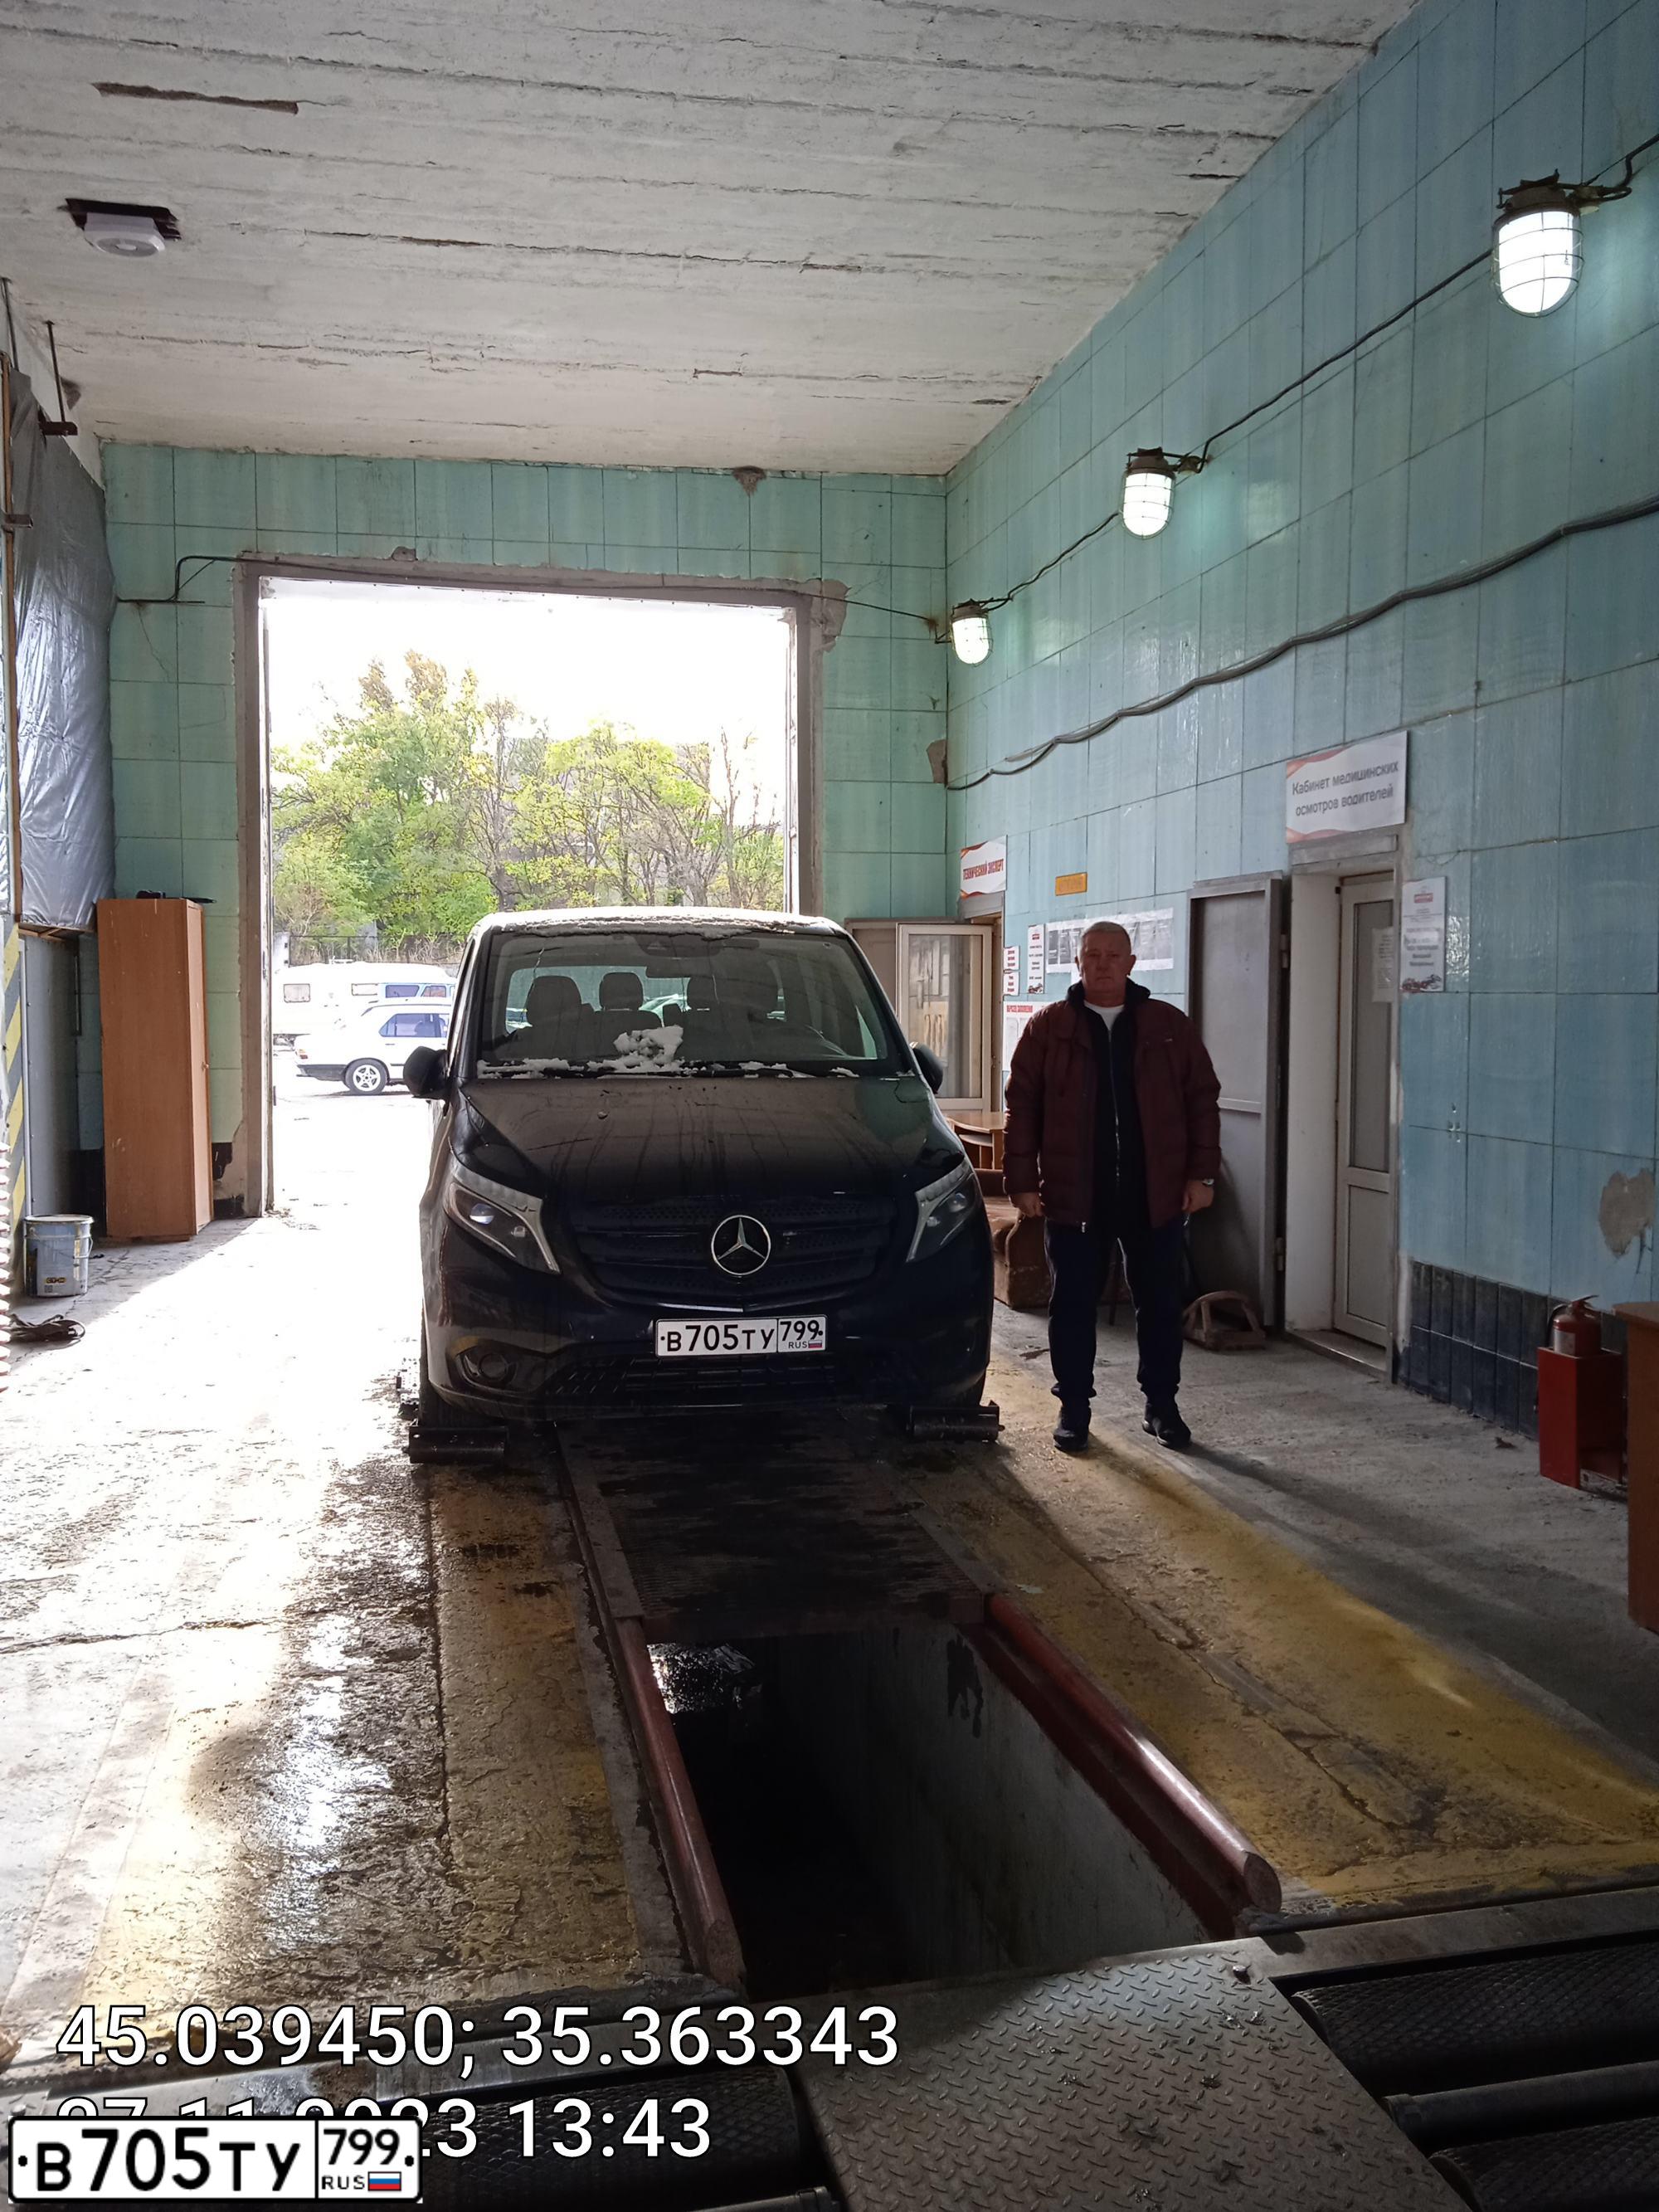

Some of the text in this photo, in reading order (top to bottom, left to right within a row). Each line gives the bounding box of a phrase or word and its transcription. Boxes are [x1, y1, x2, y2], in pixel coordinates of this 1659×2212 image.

[1292, 761, 1399, 796] Кабинет медицинских
[1295, 783, 1394, 817] осмотров водителей
[666, 1319, 820, 1352] В705ТУ 799
[788, 1341, 808, 1349] RUS
